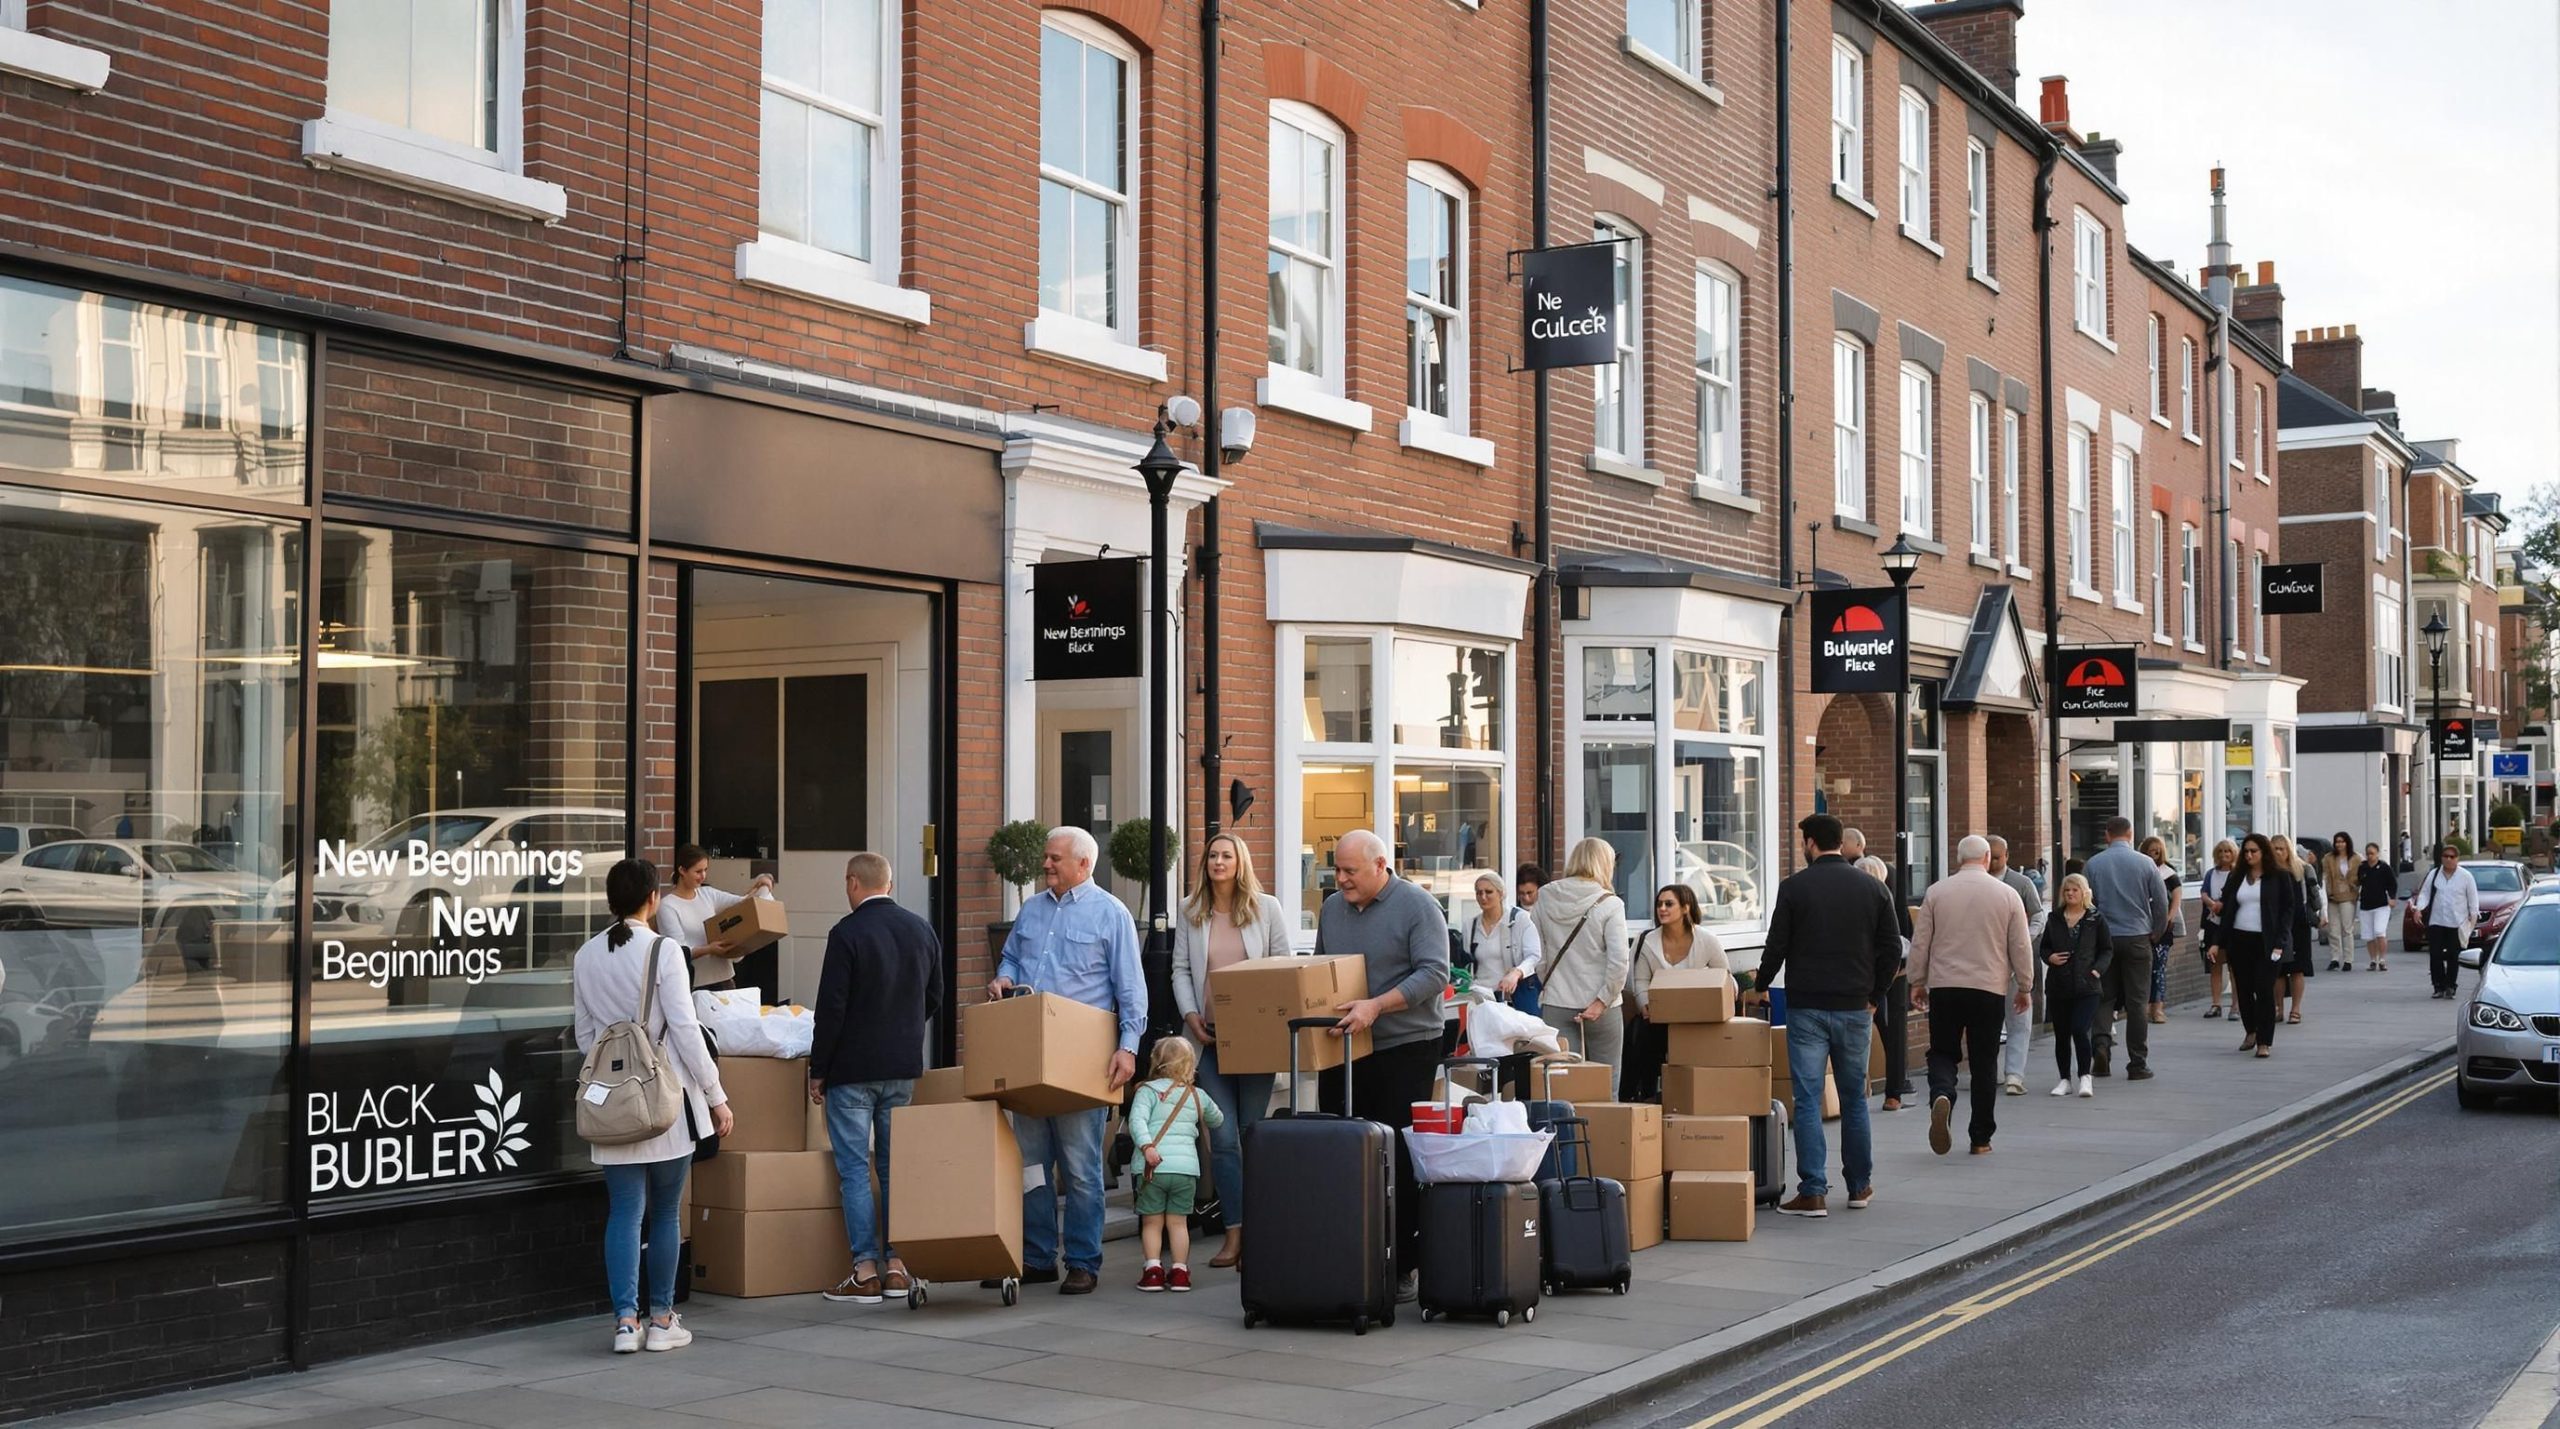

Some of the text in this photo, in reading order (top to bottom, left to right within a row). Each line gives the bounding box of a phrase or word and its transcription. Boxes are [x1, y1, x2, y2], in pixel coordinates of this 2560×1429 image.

[1538, 292, 1562, 311] Ne
[1043, 627, 1068, 640] New
[318, 838, 583, 885] New Beginnings
[432, 896, 520, 937] New
[322, 940, 501, 988] Beginnings
[307, 1083, 436, 1136] BLACK
[310, 1129, 486, 1193] BUBLER
